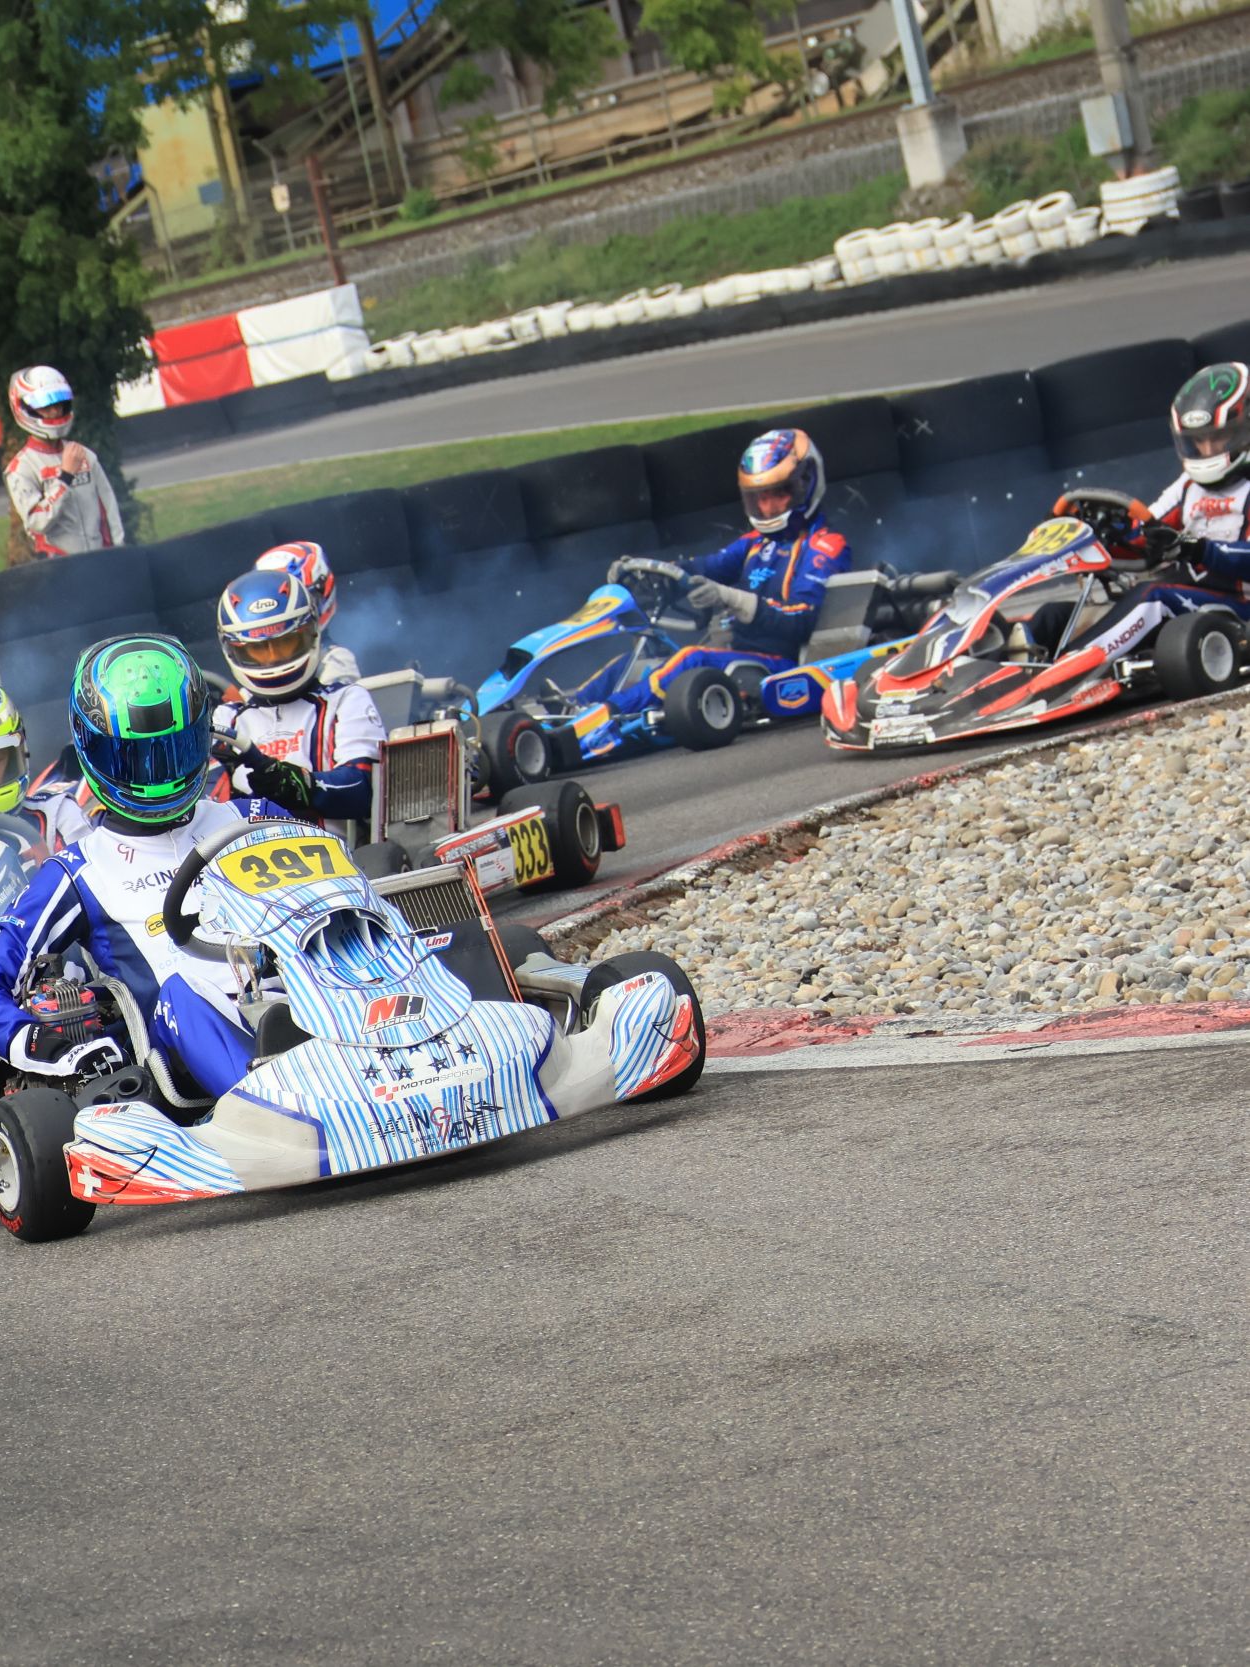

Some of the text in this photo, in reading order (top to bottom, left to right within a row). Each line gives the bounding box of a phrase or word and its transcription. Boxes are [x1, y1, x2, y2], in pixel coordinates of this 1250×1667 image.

[240, 844, 336, 890] 397
[509, 818, 549, 884] 333
[425, 935, 450, 948] Line
[363, 1014, 422, 1034] RACING
